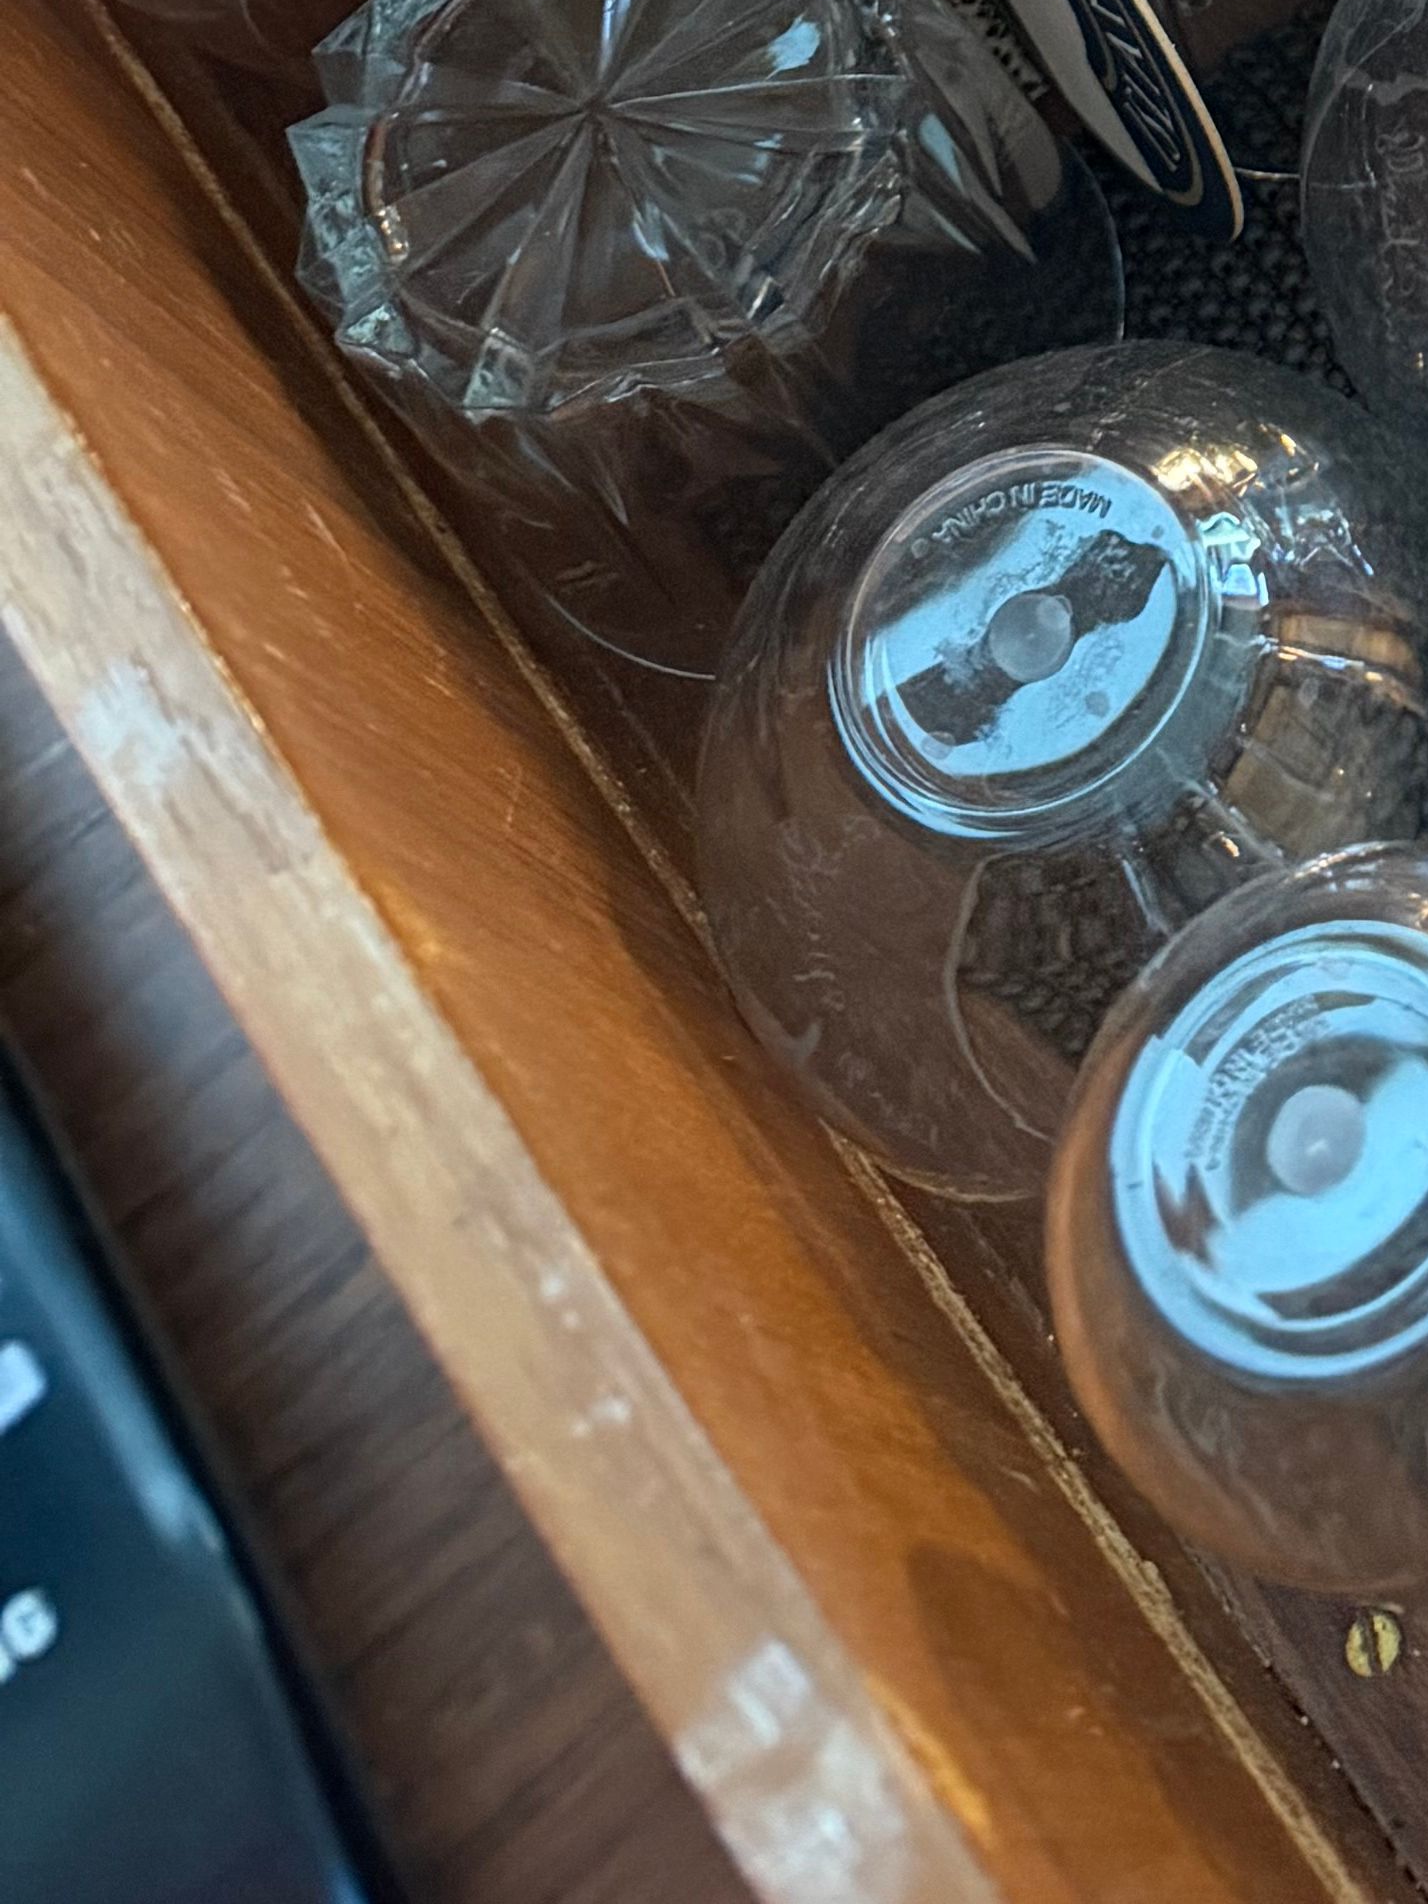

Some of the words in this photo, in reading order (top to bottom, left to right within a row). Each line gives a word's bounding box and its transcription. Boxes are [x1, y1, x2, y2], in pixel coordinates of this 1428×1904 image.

[1009, 481, 1037, 508] IN
[1039, 480, 1113, 520] MADE
[931, 490, 1007, 543] CHINA
